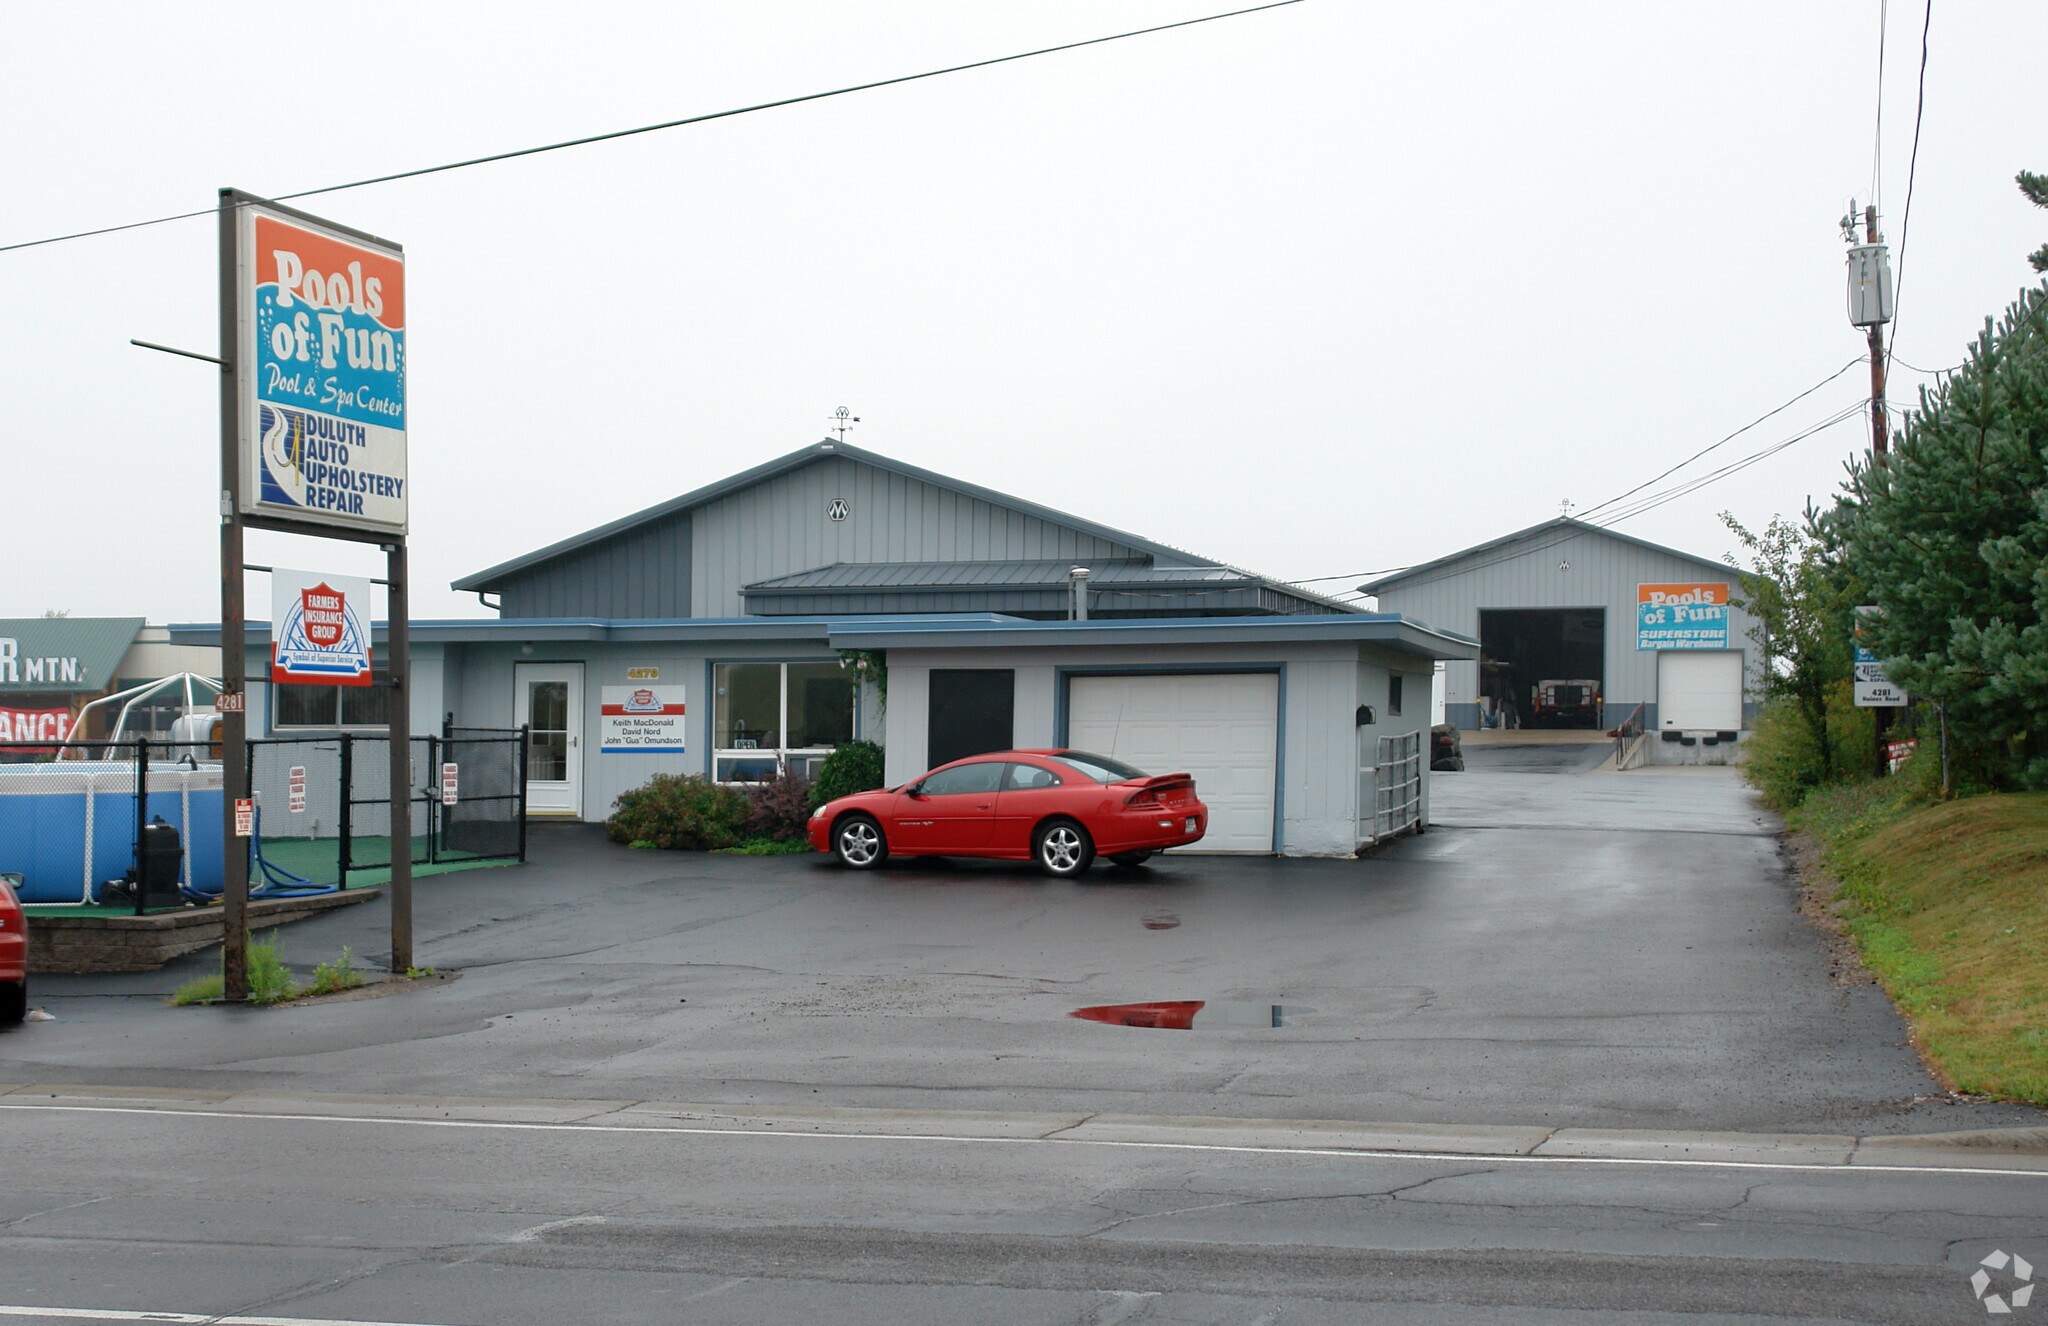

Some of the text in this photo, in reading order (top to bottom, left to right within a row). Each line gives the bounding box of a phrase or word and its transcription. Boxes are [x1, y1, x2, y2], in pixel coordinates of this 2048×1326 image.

[273, 250, 383, 317] Pools
[272, 312, 396, 371] of Fun
[265, 362, 402, 416] Pool & Spa Center
[306, 414, 366, 447] DULUTH
[306, 438, 349, 465] AUTO
[306, 461, 403, 498] UPHOLSTERY
[306, 484, 364, 514] REPAIR
[308, 595, 339, 609] FARMERS
[1649, 587, 1714, 608] Pools
[305, 610, 342, 624] INSURANCE
[1645, 606, 1721, 624] of Fun
[312, 625, 336, 639] GROUP
[1640, 630, 1726, 638] SUPERSTORE
[1641, 639, 1724, 648] Bargain Warehouse
[293, 652, 310, 662] Symbol
[311, 653, 316, 661] of
[317, 653, 336, 663] Superior
[217, 695, 242, 709] 4281
[737, 741, 755, 749] OPEN
